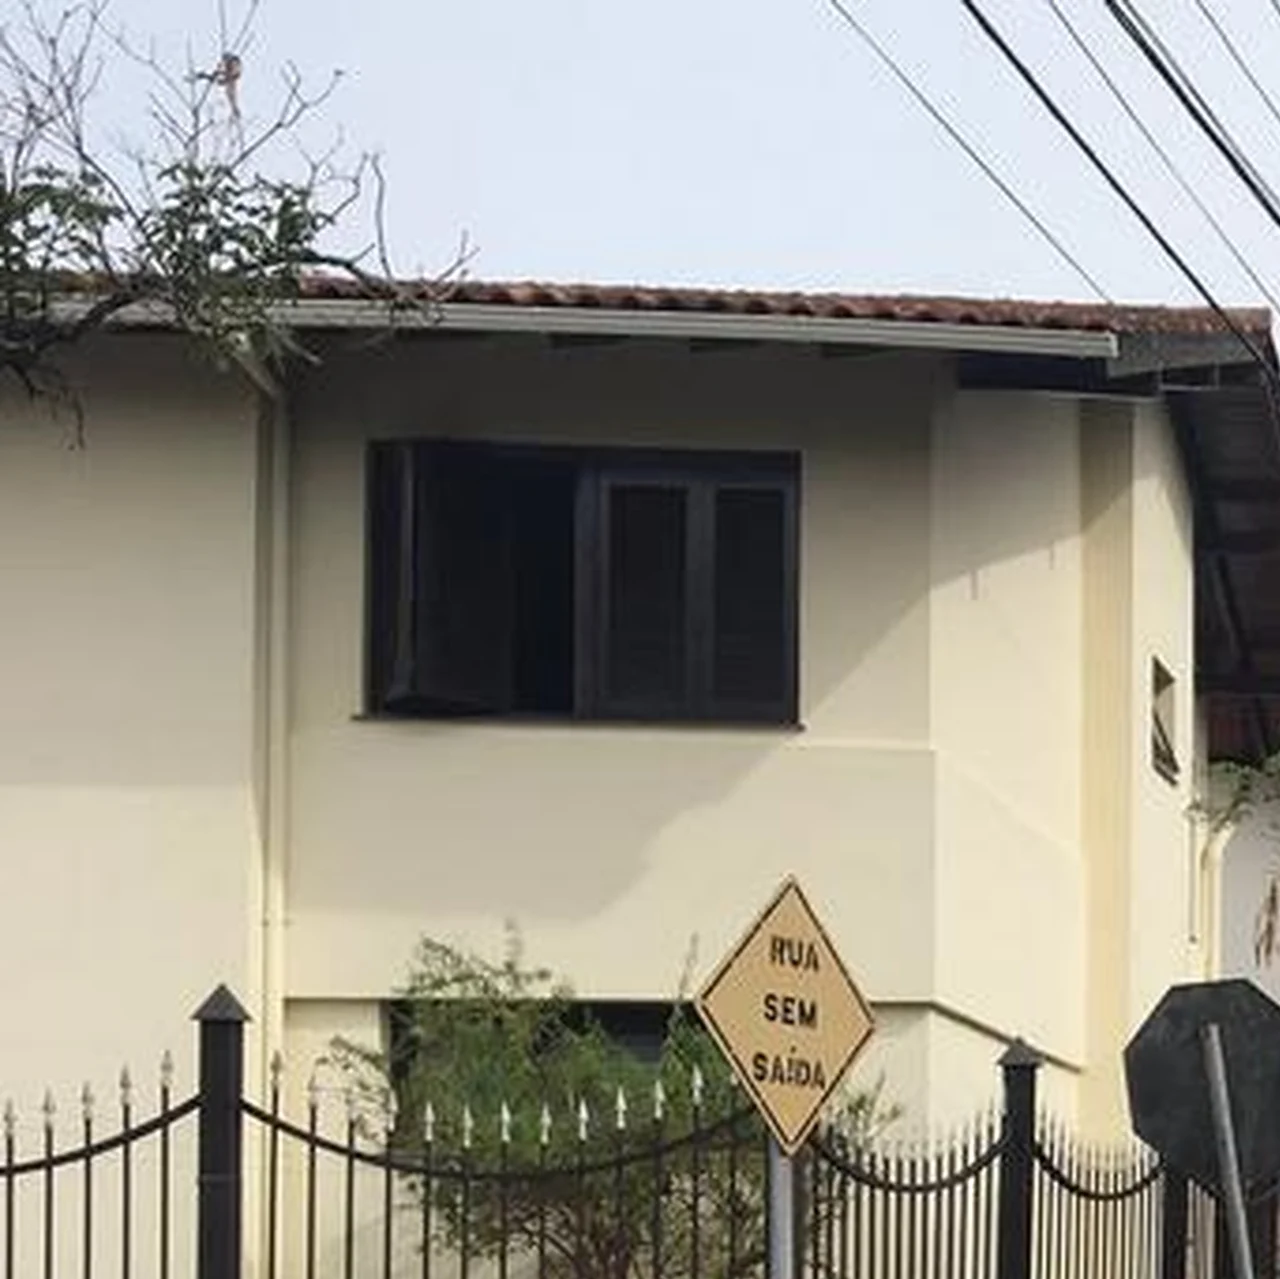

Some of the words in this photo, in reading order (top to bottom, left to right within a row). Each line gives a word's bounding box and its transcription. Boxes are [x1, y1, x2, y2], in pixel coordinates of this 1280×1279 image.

[769, 935, 819, 972] RUA
[763, 993, 818, 1029] SEM
[752, 1045, 826, 1090] SAÍDA
